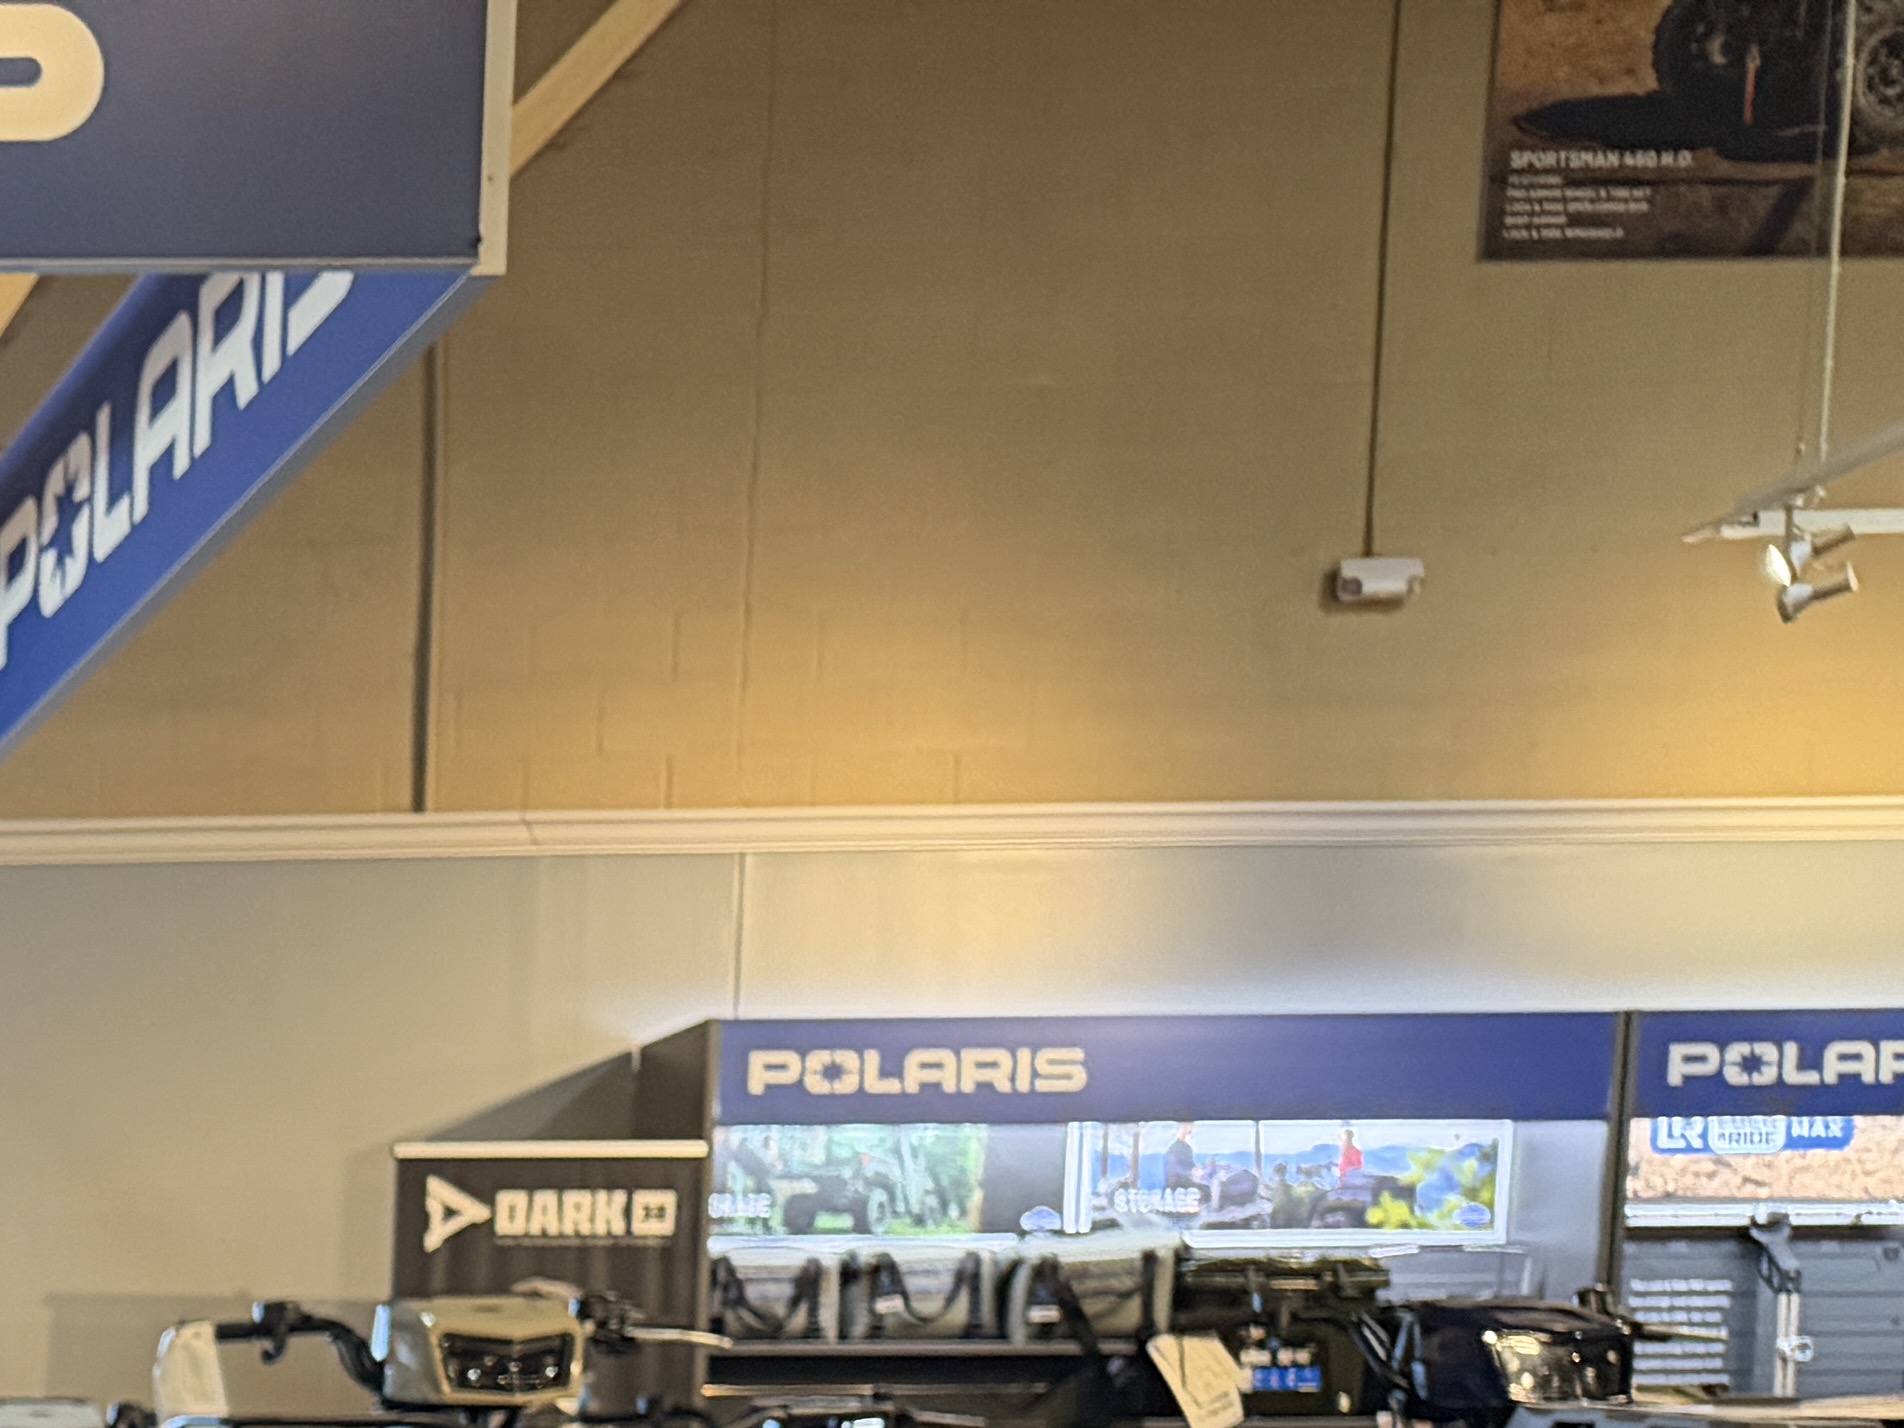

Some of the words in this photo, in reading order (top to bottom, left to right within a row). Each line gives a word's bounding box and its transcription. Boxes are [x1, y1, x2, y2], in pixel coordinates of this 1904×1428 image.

[1509, 150, 1620, 169] SPORTSMAN
[747, 1047, 1088, 1095] POLARIS
[495, 1188, 628, 1236] DARK
